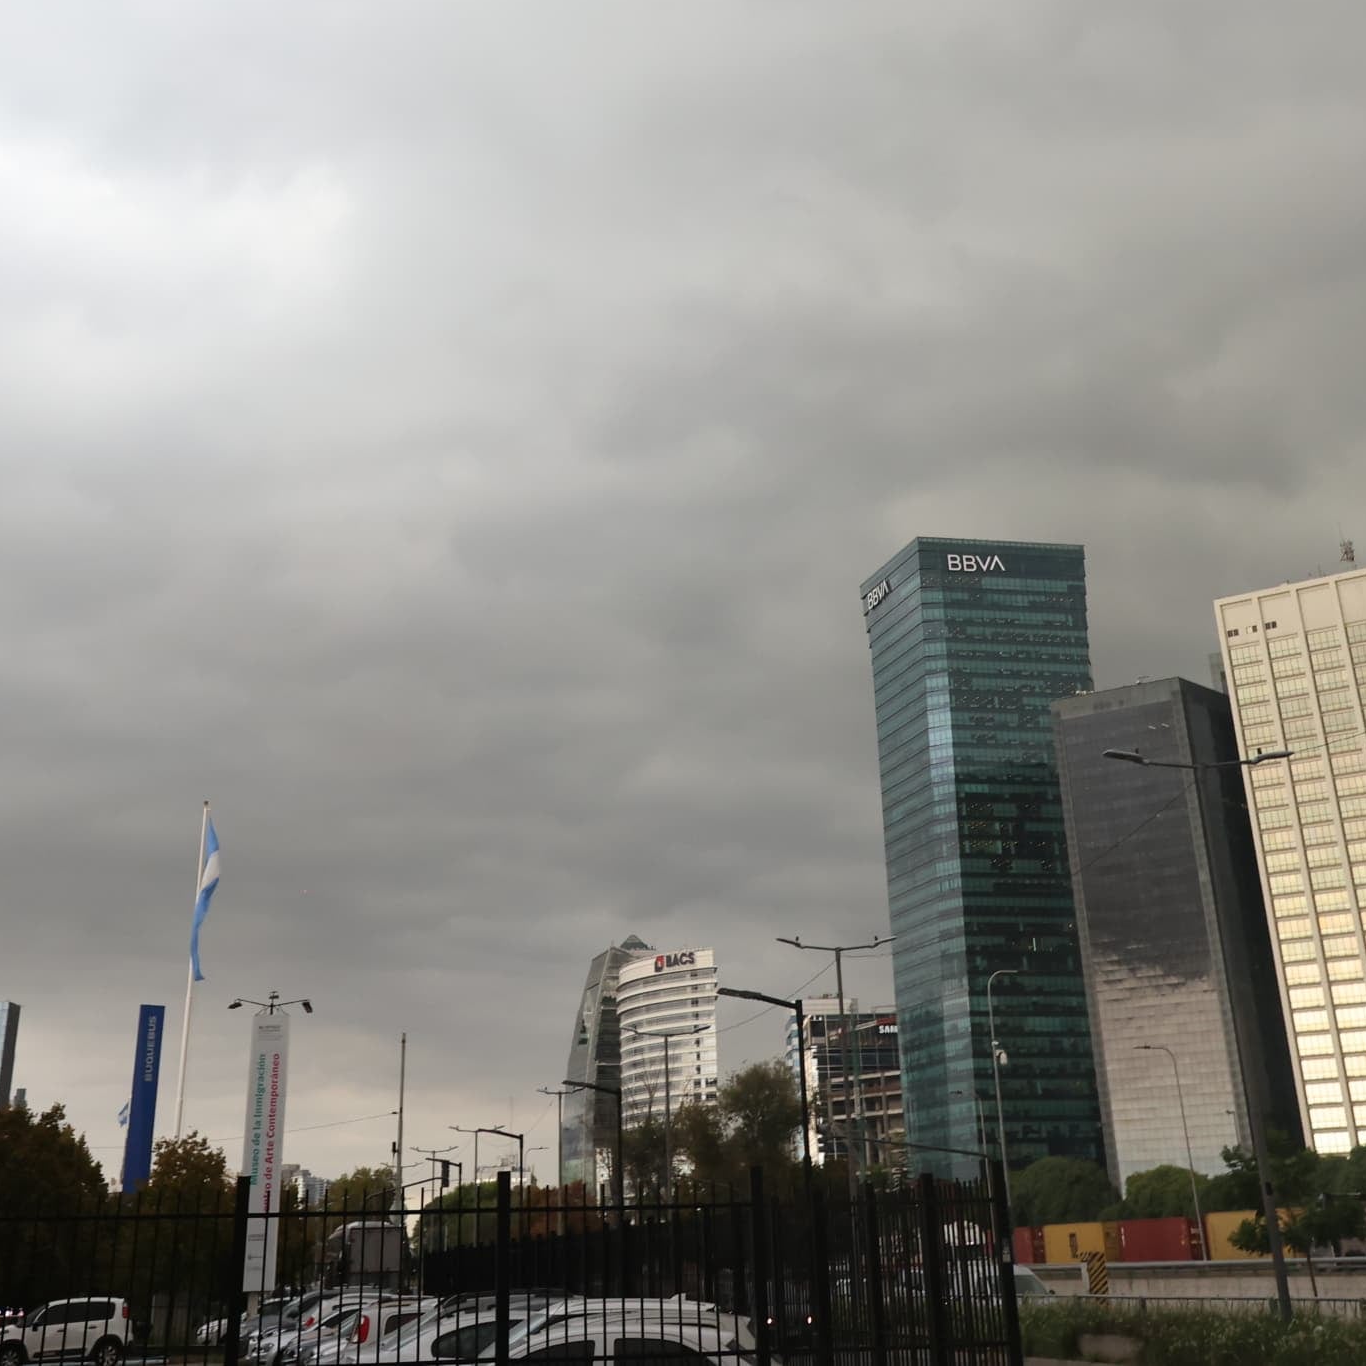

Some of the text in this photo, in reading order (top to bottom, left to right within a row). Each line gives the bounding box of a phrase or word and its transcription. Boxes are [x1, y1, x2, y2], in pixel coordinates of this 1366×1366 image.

[947, 554, 1006, 572] BBVA
[867, 579, 890, 610] BBVA
[666, 951, 695, 968] BACS
[144, 1016, 157, 1083] BUQUEBUS
[267, 1053, 281, 1139] Contemporáneo
[250, 1054, 266, 1186] Museo de la Inmigración
[265, 1140, 275, 1164] Arte
[264, 1166, 273, 1180] de
